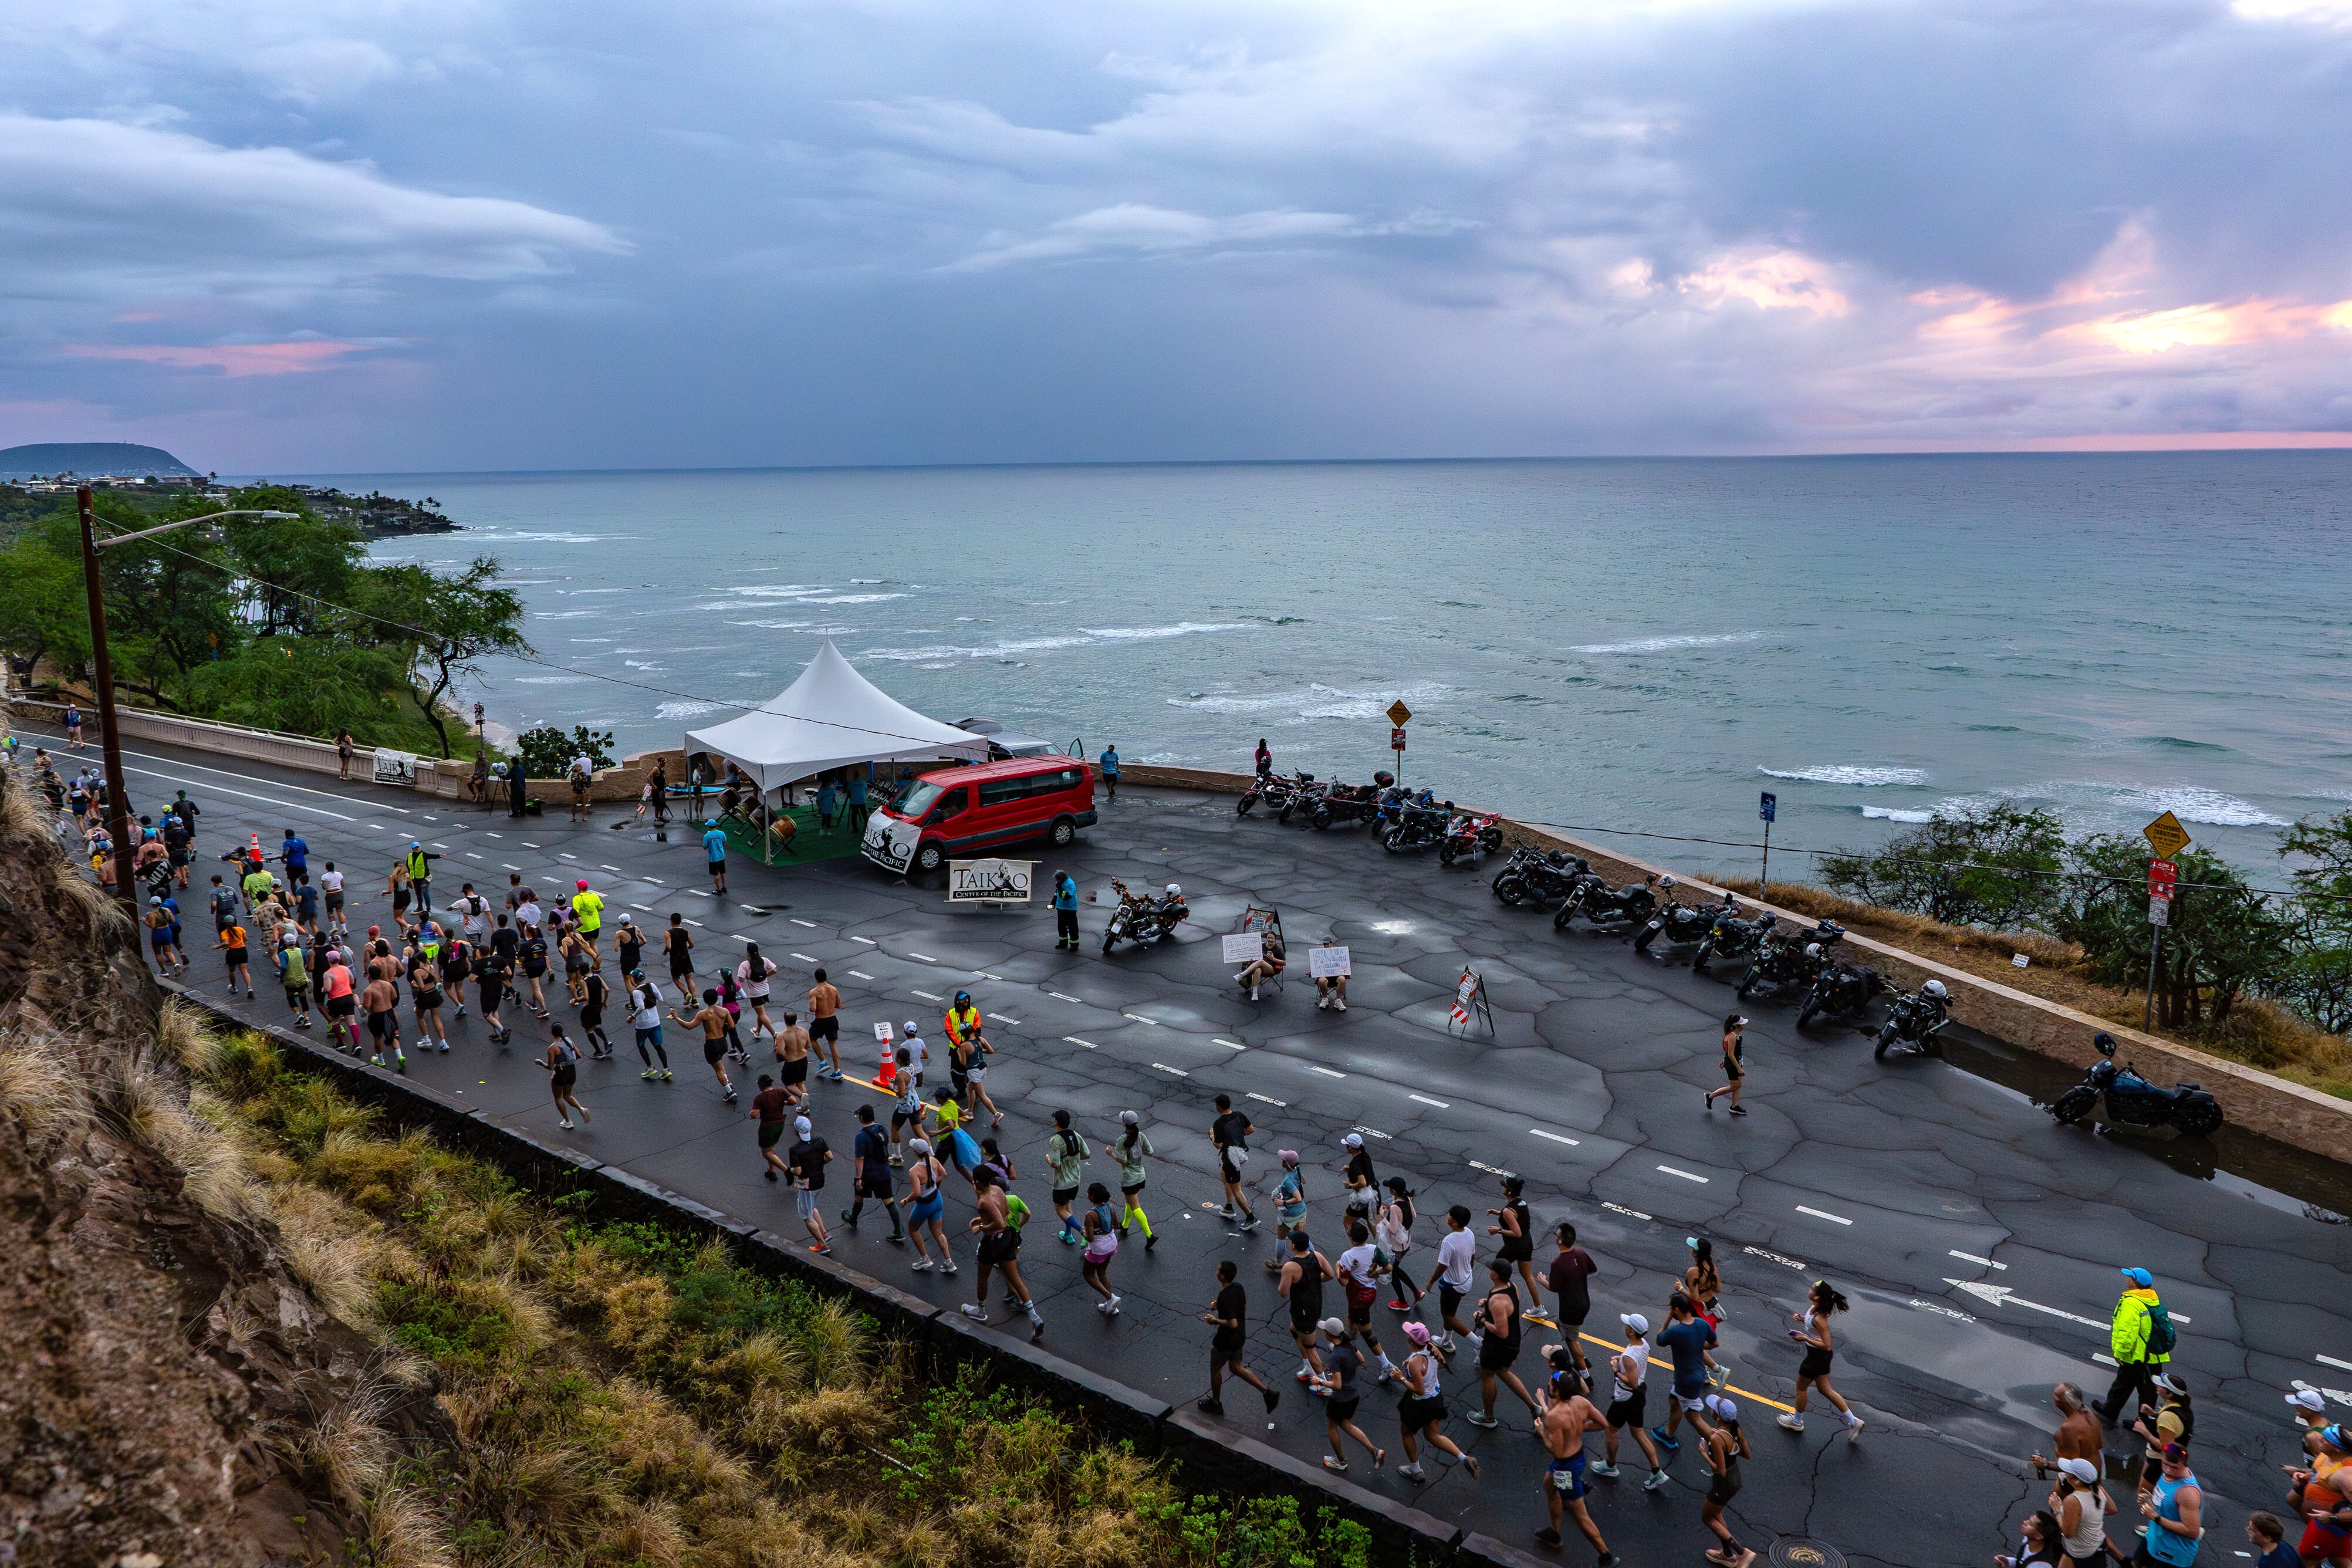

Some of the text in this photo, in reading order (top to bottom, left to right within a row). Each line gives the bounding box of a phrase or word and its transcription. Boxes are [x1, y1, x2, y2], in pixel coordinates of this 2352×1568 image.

[375, 755, 413, 776] TAIKO
[870, 849, 904, 867] THE PACIFIC
[954, 869, 1028, 889] TAIKO
